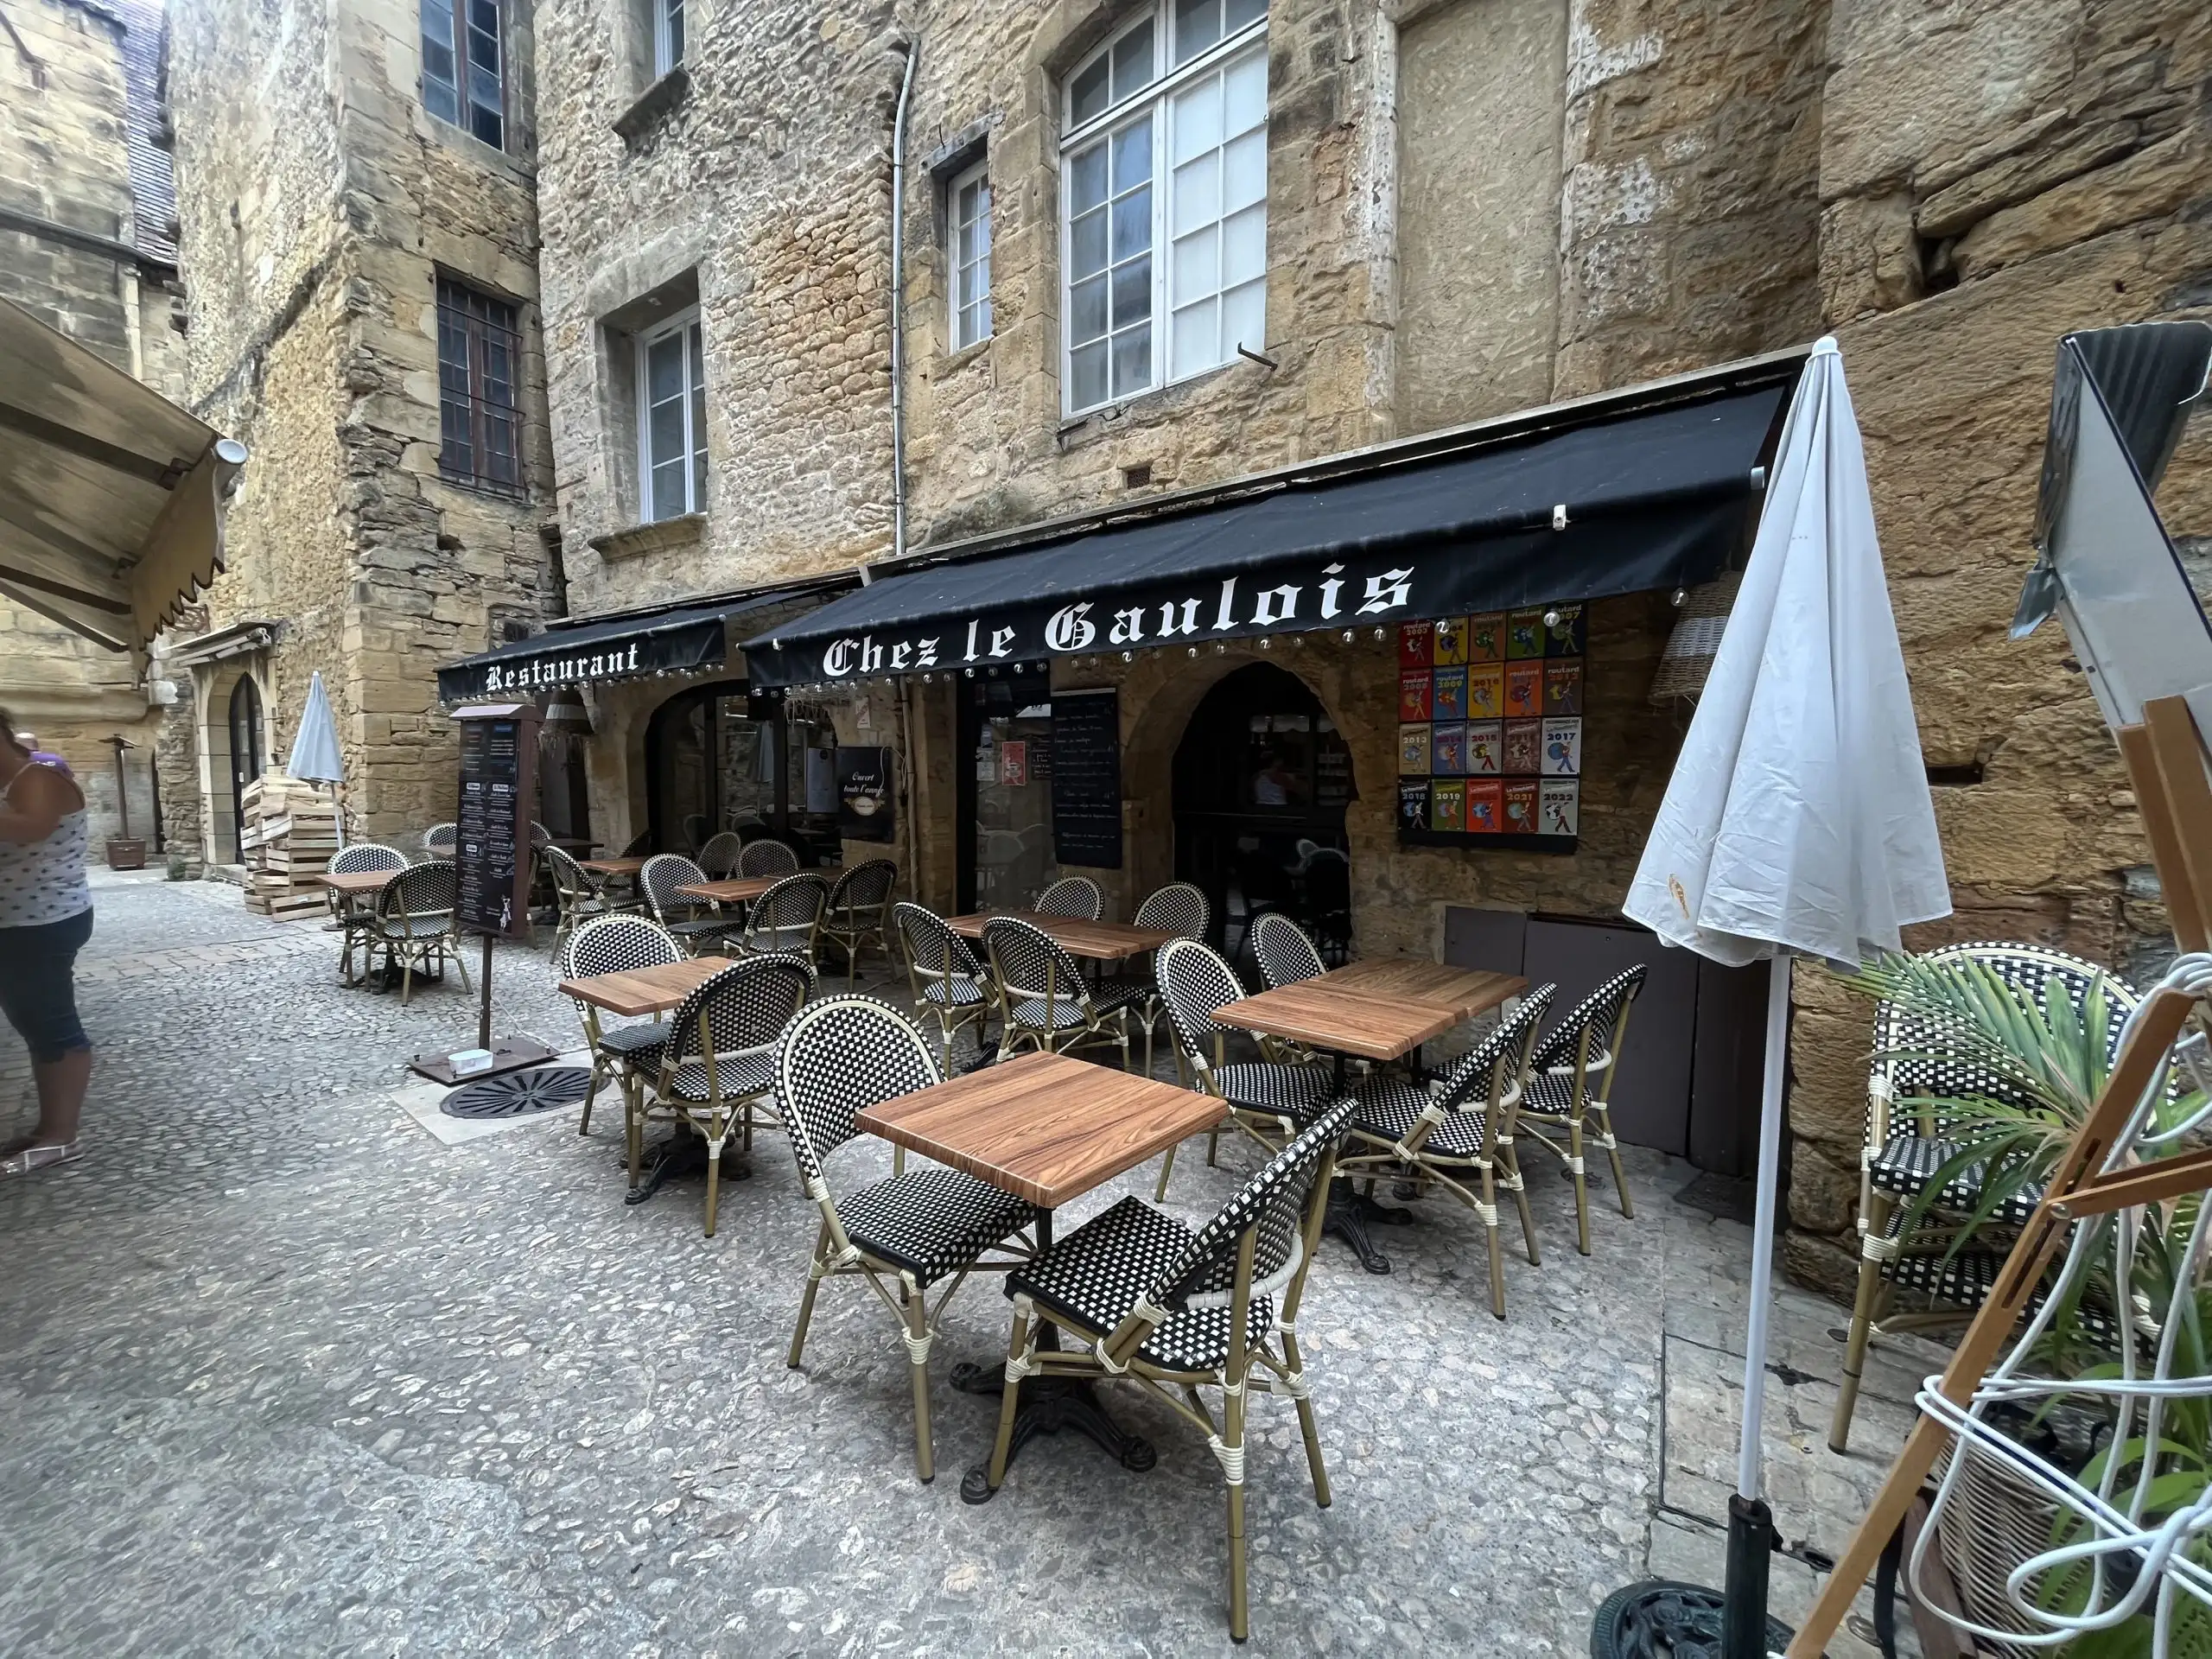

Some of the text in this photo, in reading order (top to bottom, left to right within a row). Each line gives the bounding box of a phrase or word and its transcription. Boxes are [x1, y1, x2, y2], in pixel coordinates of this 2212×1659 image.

[823, 563, 1415, 677] Chez le Gaulois
[1402, 621, 1431, 630] routard
[485, 643, 639, 692] Restaurant
[1509, 668, 1540, 677] routard
[1435, 673, 1465, 682] routard
[1547, 732, 1577, 741] 2017
[851, 771, 874, 782] Ouvert
[843, 784, 860, 793] toute
[1506, 792, 1533, 801] 2021
